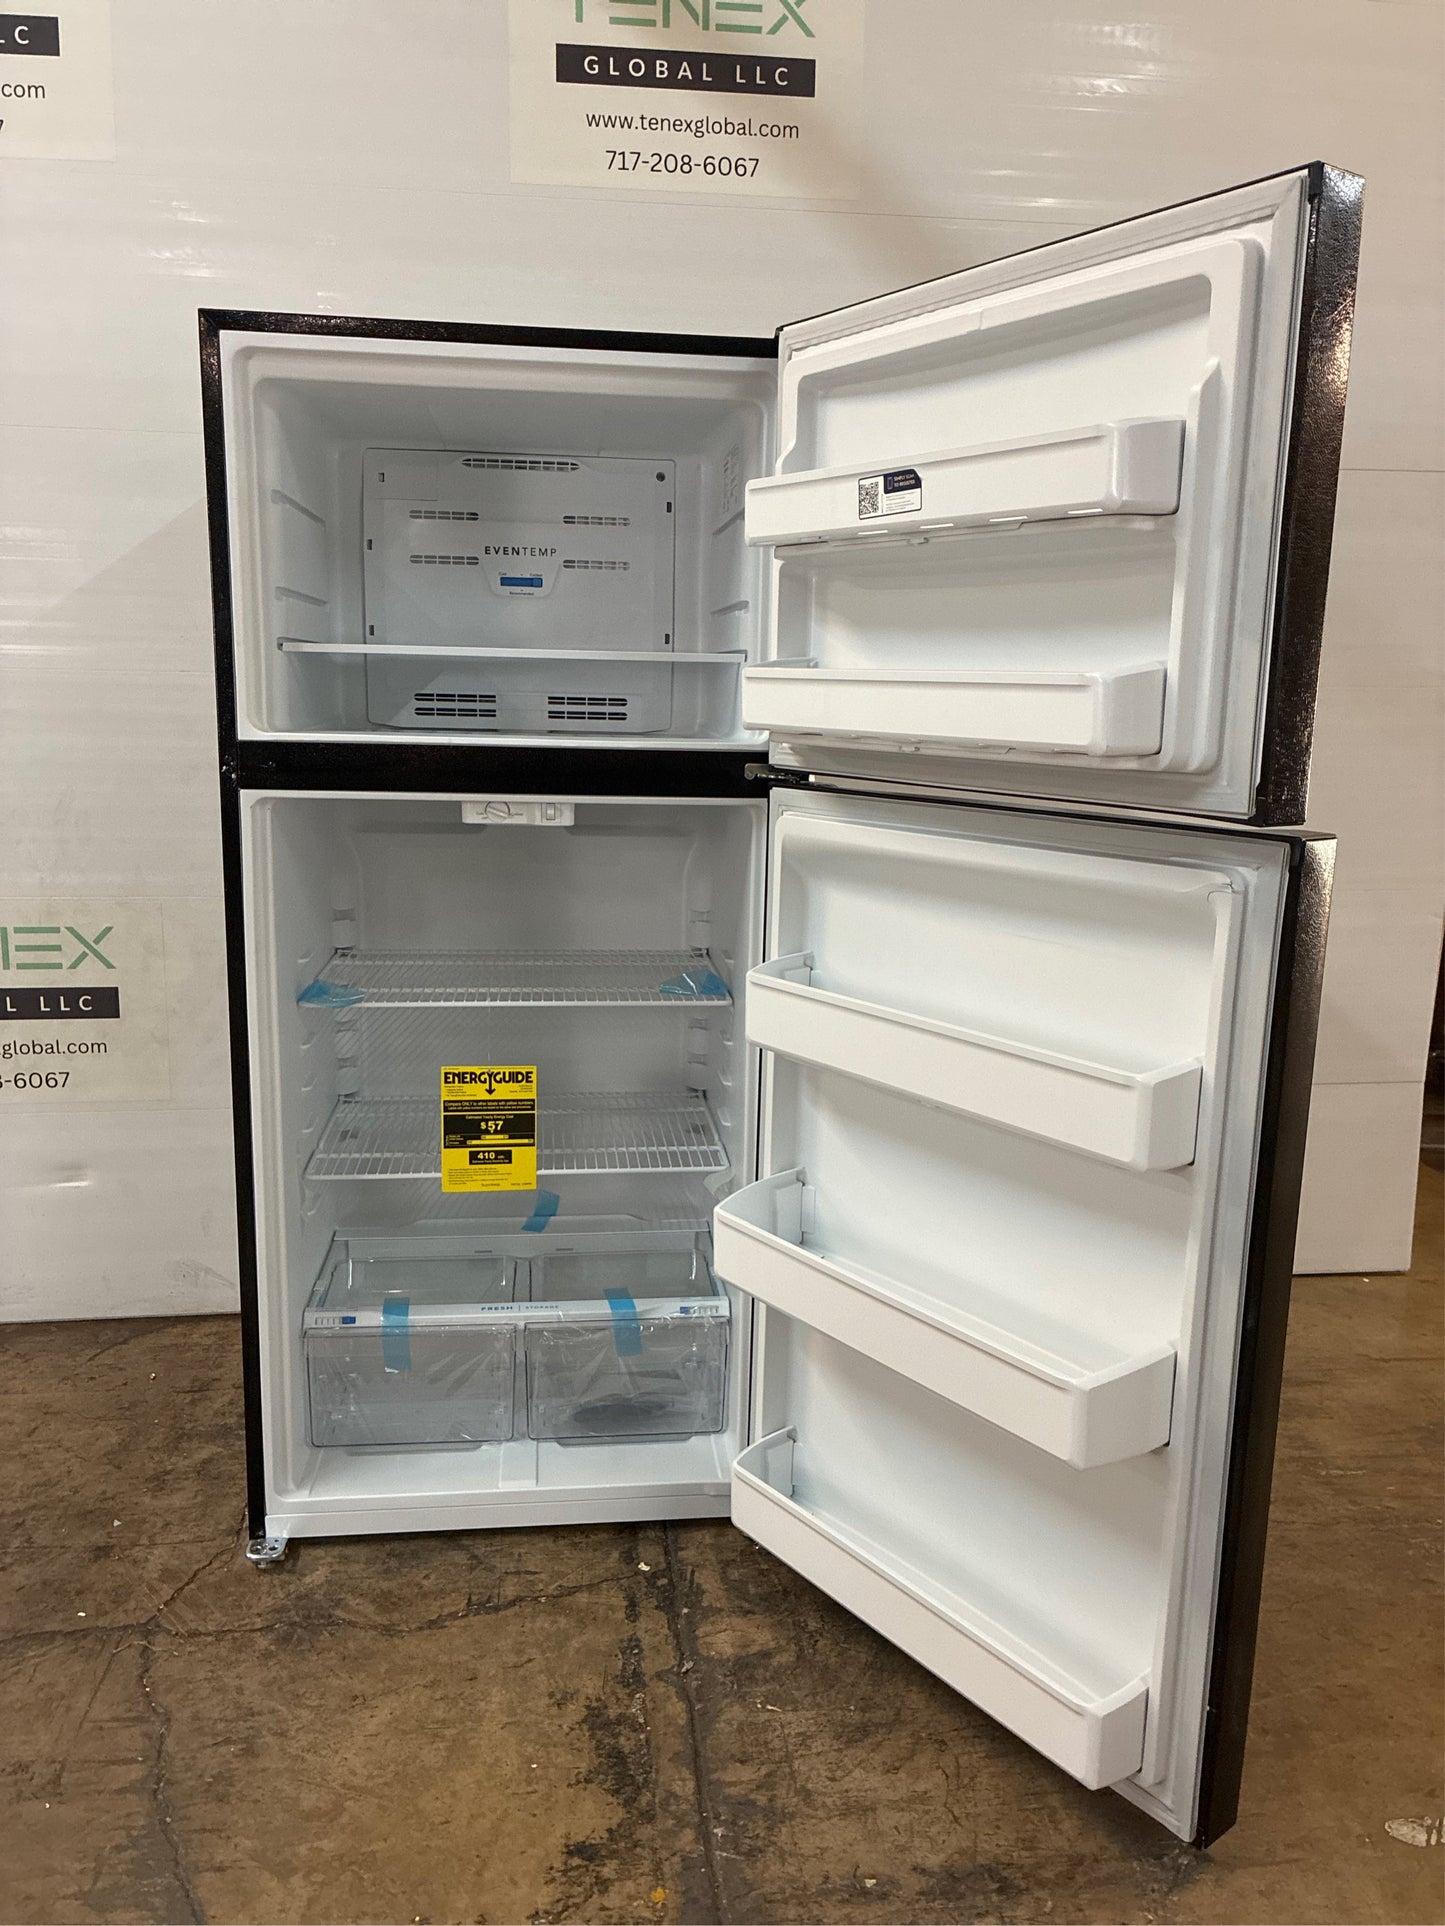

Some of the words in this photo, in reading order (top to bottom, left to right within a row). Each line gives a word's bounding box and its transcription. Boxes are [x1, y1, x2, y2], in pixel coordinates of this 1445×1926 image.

[583, 55, 713, 81] GLOBAL
[736, 65, 789, 86] LLC
[586, 112, 800, 139] www.tenexglobal.com
[605, 150, 760, 178] 717-208-6067
[484, 545, 557, 557] EVENTEMP
[0, 926, 117, 970] EX
[40, 995, 93, 1011] LLC
[0, 1039, 108, 1059] global.com
[0, 1072, 70, 1089] -6067
[444, 1071, 533, 1084] ENERGYGUIDE
[477, 1151, 496, 1160] 410
